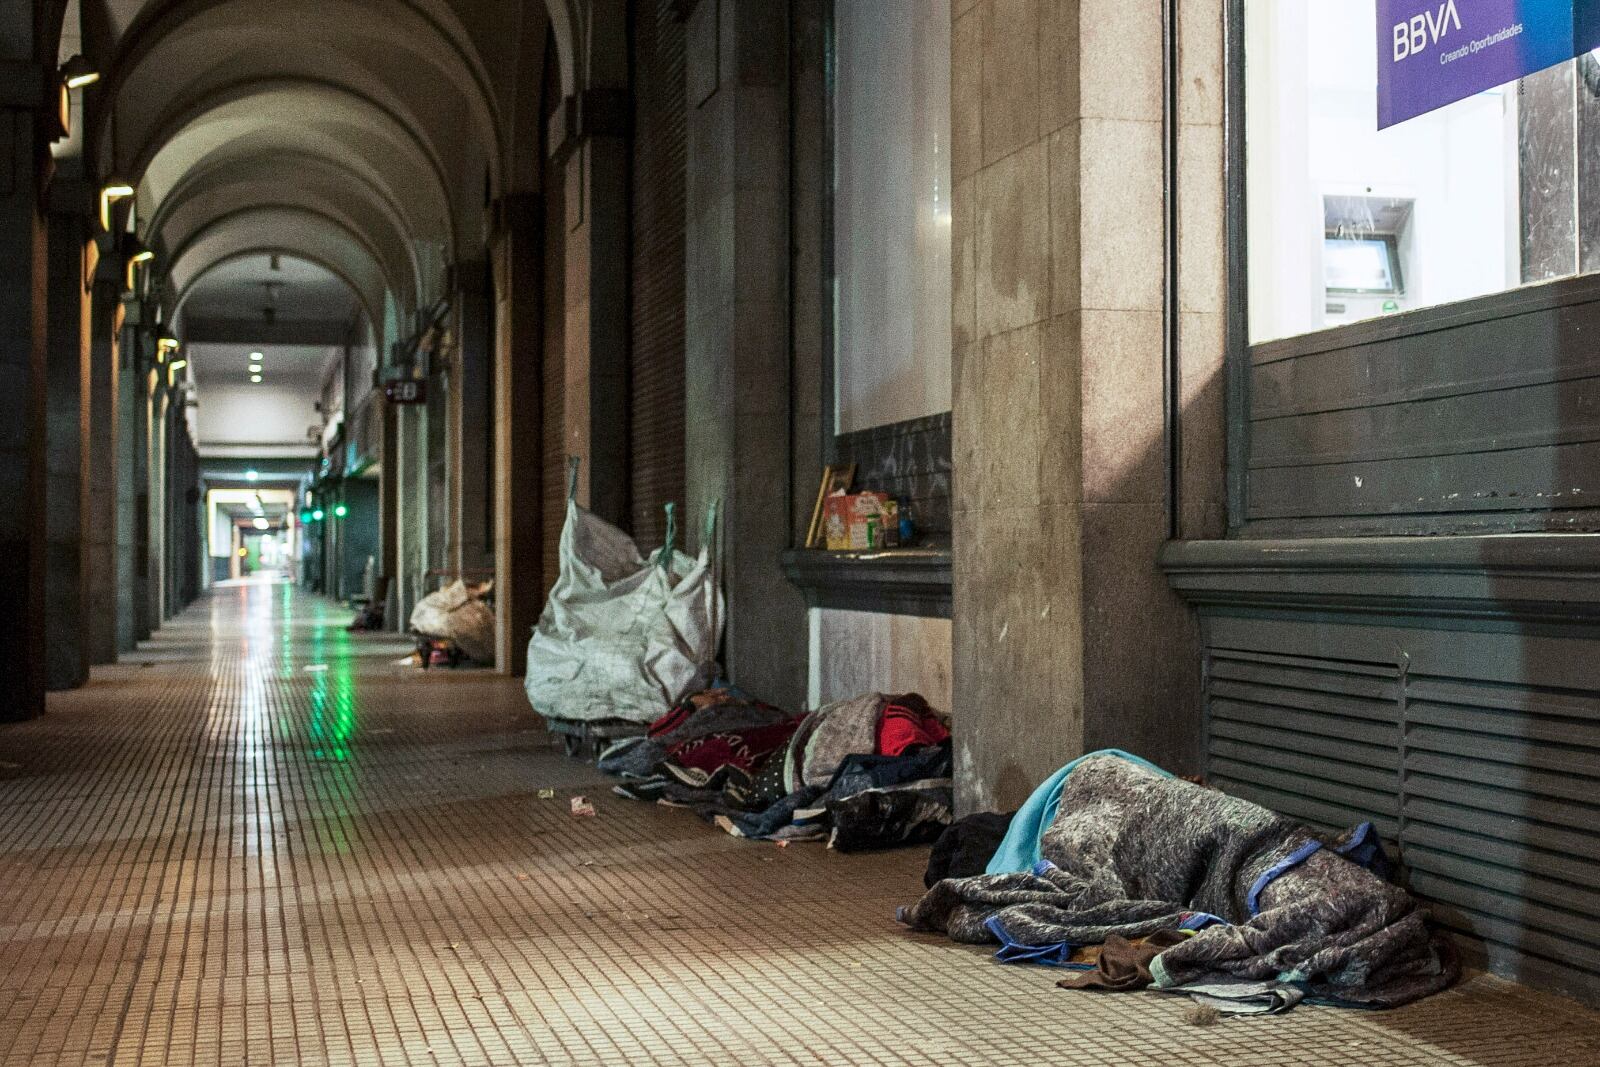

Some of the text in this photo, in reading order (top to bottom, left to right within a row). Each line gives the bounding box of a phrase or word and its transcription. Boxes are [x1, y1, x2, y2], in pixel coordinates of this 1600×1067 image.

[1393, 0, 1462, 62] BBVA
[1440, 23, 1523, 65] Creando Oportunidades
